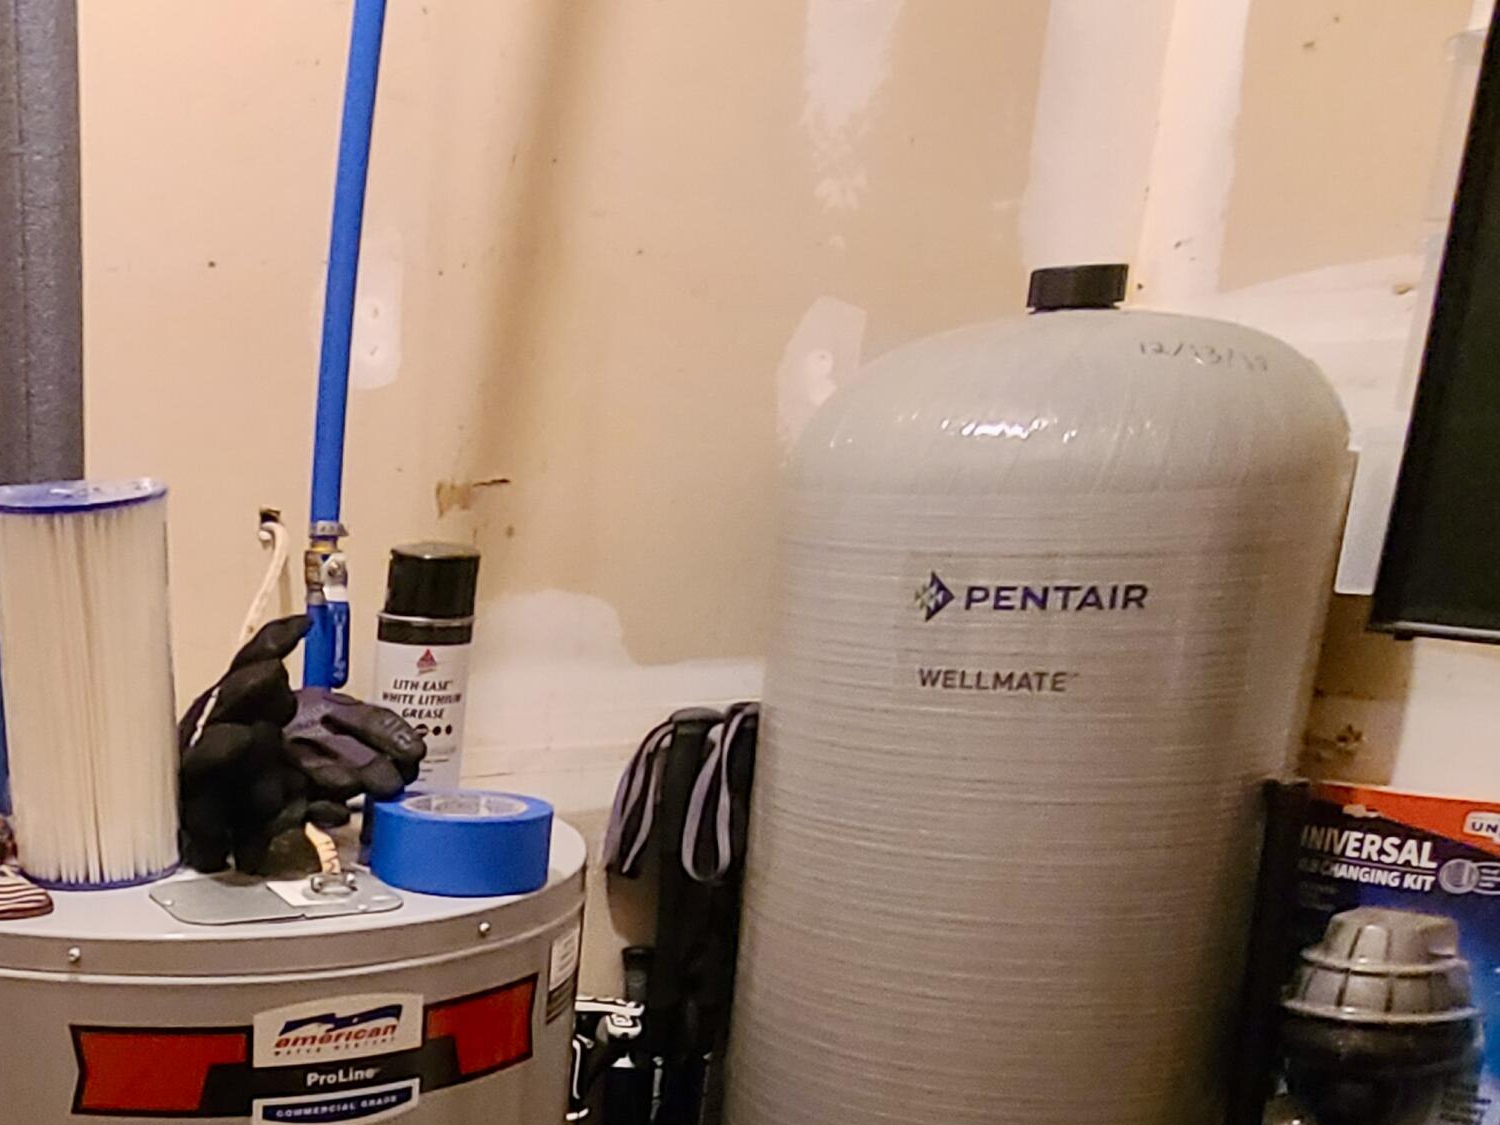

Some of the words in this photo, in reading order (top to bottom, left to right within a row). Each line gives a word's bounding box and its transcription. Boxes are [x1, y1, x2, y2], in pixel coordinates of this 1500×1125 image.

[963, 583, 1150, 612] PENTAIR
[401, 707, 445, 720] GREASE
[1402, 874, 1436, 892] KIT
[274, 1023, 398, 1049] american
[275, 1103, 357, 1118] COMMERCIAL
[360, 1094, 398, 1108] GRADE
